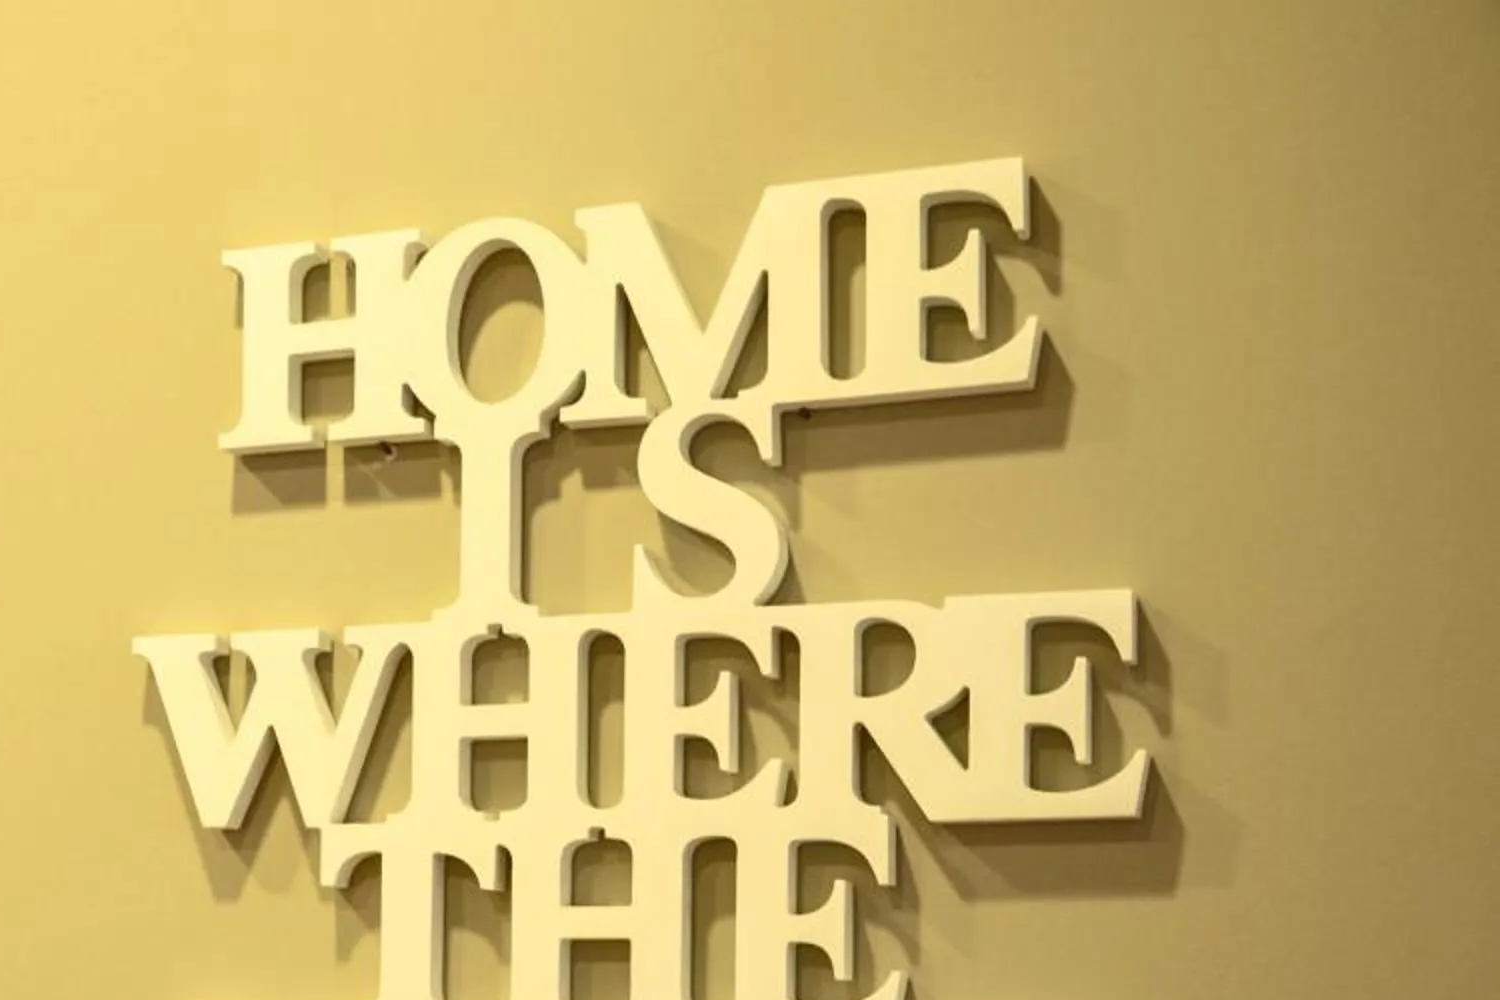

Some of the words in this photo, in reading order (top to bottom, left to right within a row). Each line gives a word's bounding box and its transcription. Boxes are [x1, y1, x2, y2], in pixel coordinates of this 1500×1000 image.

[219, 156, 1042, 455] HOME
[431, 398, 790, 618] IS
[131, 587, 1150, 831] WHERE
